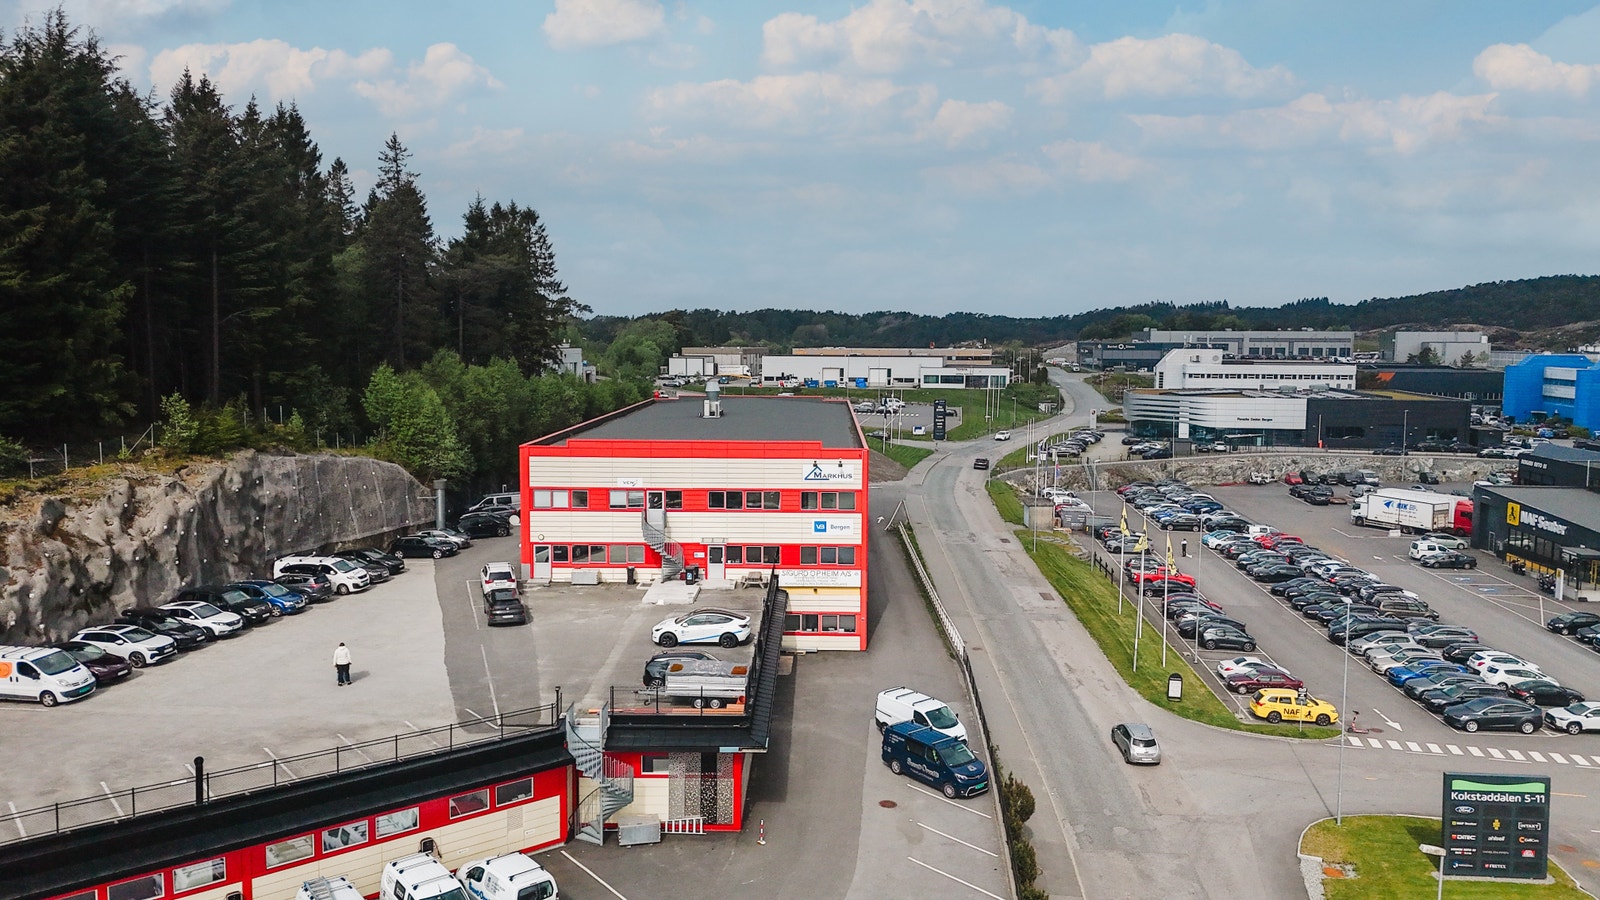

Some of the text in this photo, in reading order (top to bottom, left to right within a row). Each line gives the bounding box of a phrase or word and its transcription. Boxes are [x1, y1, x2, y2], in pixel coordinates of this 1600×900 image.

[1520, 510, 1567, 535] NAF Senter
[1451, 792, 1521, 802] Kokstaddalen
